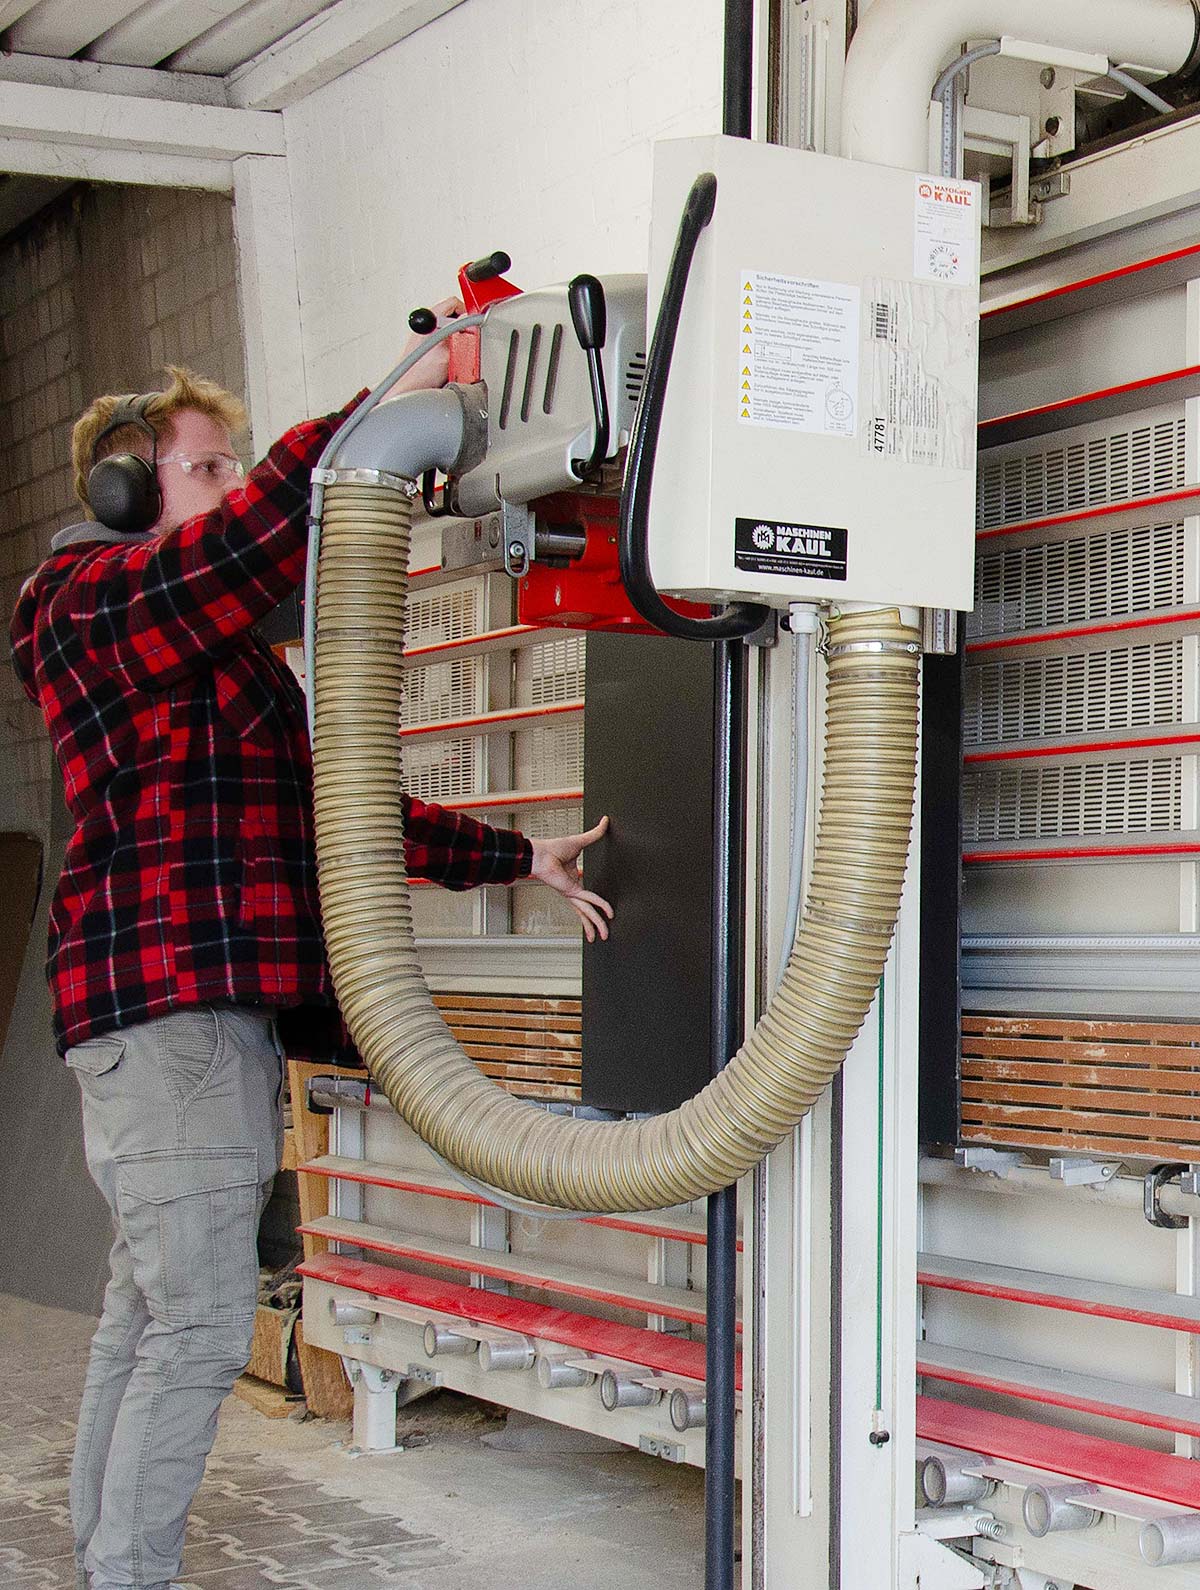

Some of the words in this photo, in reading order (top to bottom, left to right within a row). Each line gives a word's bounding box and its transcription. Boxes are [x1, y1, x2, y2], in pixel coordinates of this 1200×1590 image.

[934, 191, 972, 206] KAUL
[873, 417, 885, 453] 47781
[776, 526, 832, 540] MASCHINEN
[776, 536, 832, 556] KAUL
[758, 564, 824, 576] www.maschinen-kaul.de
